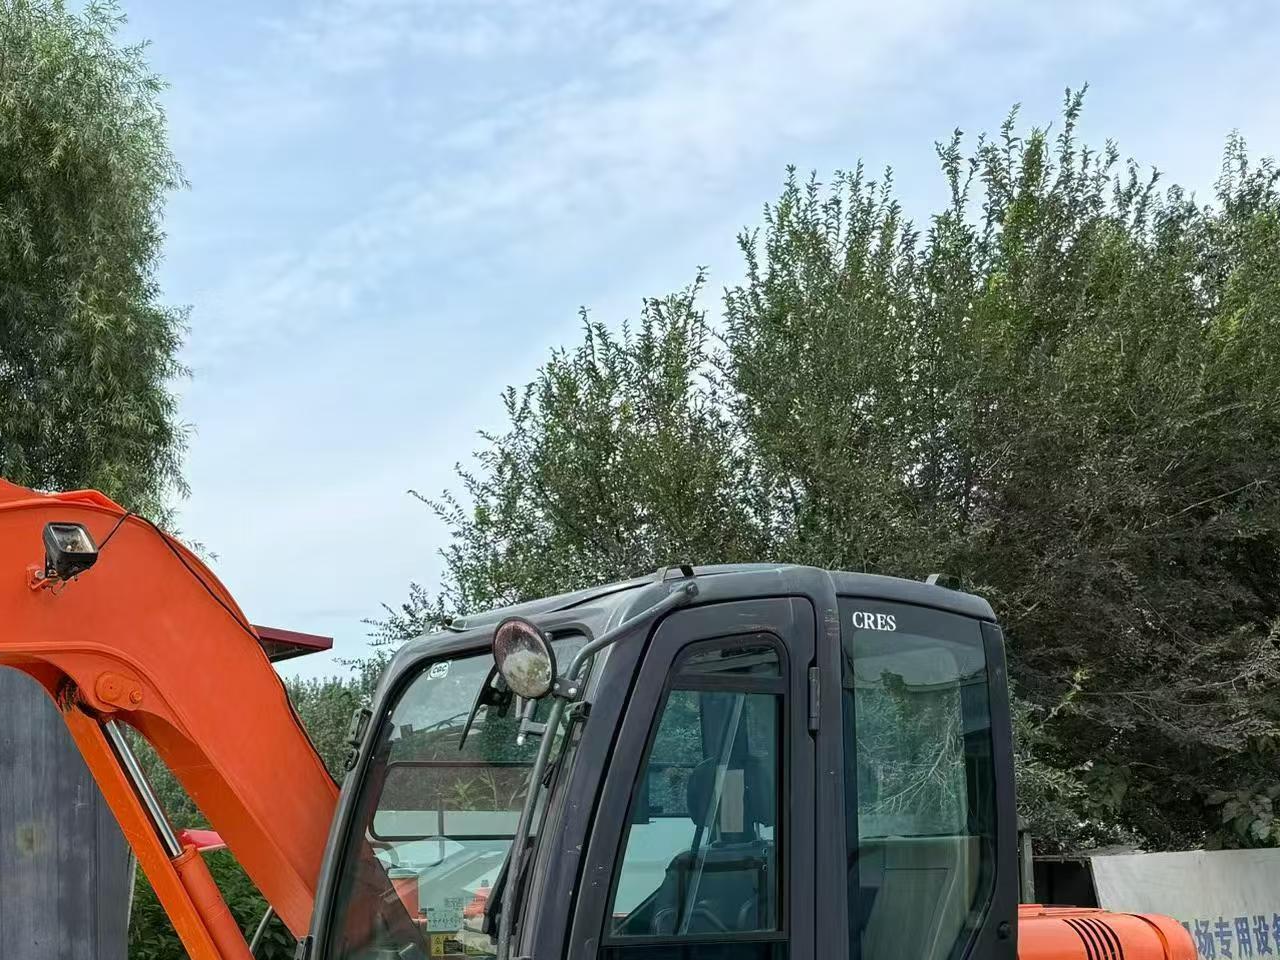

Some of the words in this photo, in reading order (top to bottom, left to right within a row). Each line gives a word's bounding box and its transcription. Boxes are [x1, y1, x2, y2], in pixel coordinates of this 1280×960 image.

[852, 611, 897, 632] CRES
[1181, 912, 1280, 960] 场专用设
